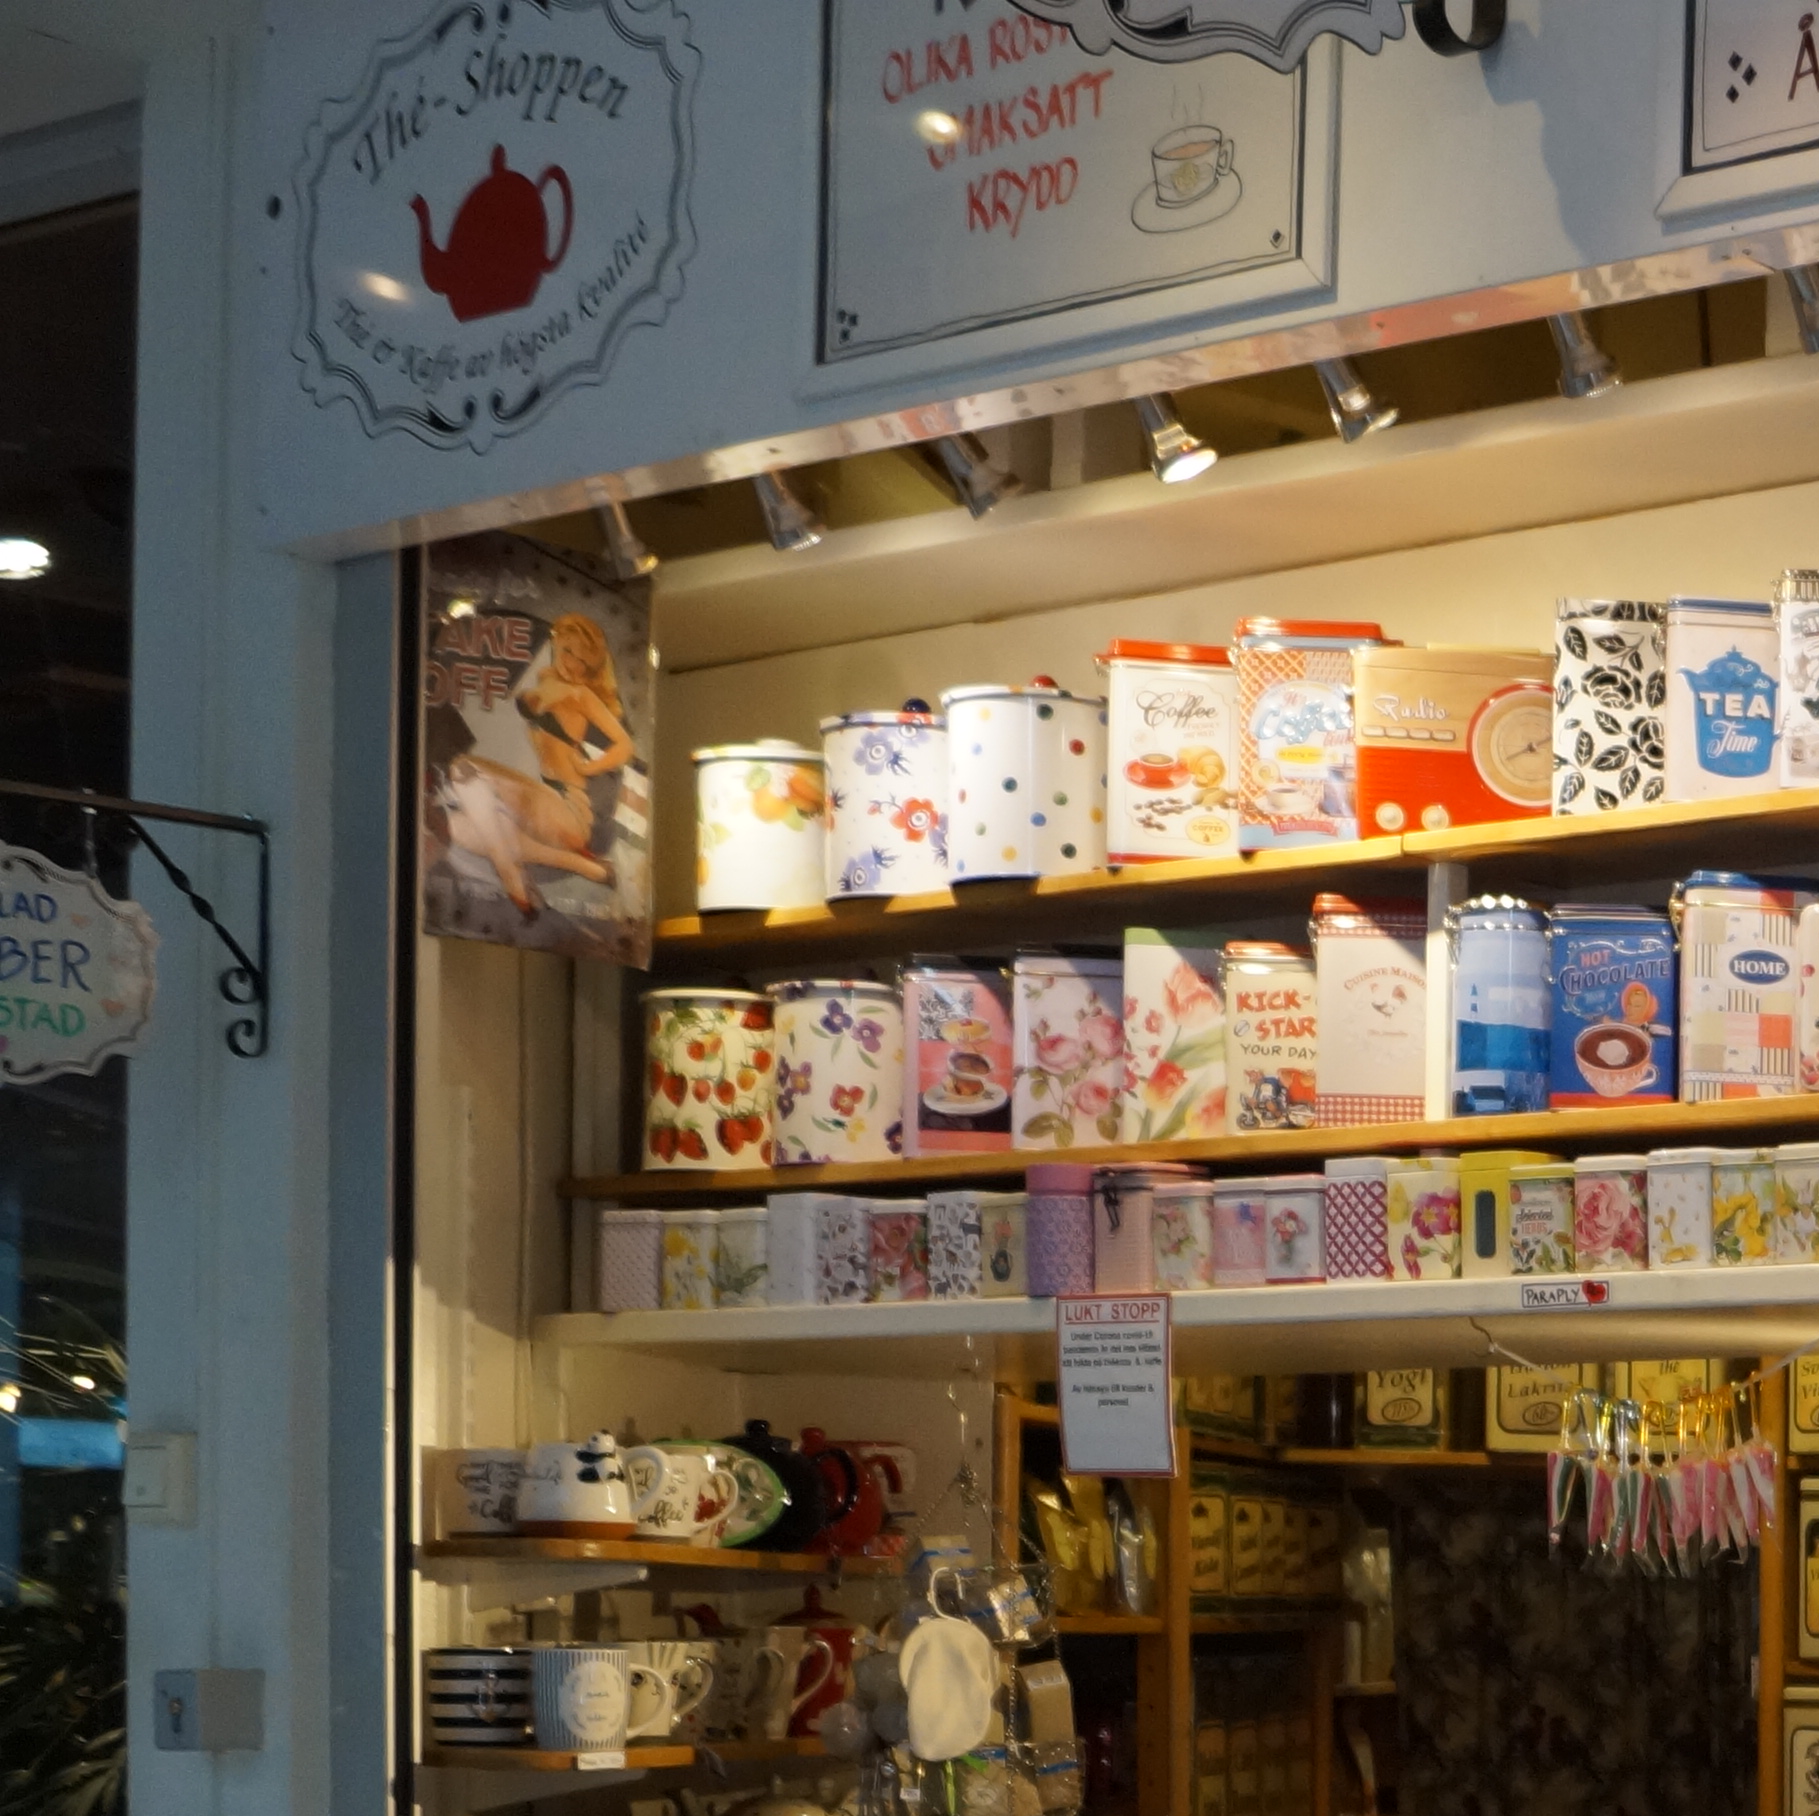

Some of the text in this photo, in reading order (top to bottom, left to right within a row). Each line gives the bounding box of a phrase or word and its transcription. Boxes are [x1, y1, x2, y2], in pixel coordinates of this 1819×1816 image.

[881, 33, 975, 104] OLIKA
[965, 156, 1079, 239] KRYDD
[1135, 690, 1219, 731] Coffee
[1372, 694, 1448, 722] Radio
[1698, 692, 1773, 721] TEA
[1705, 719, 1758, 759] Time
[1580, 950, 1611, 969] HOT
[1732, 959, 1787, 977] HOME
[1343, 966, 1426, 991] CUISINE MAISO
[1559, 957, 1670, 995] CHOCOLATE
[1235, 988, 1311, 1013] KICK-
[1254, 1016, 1317, 1041] STAR
[1240, 1043, 1317, 1060] YOUR DAY
[1524, 1288, 1580, 1304] PARAPLY
[1064, 1302, 1161, 1321] LUKT STOPP
